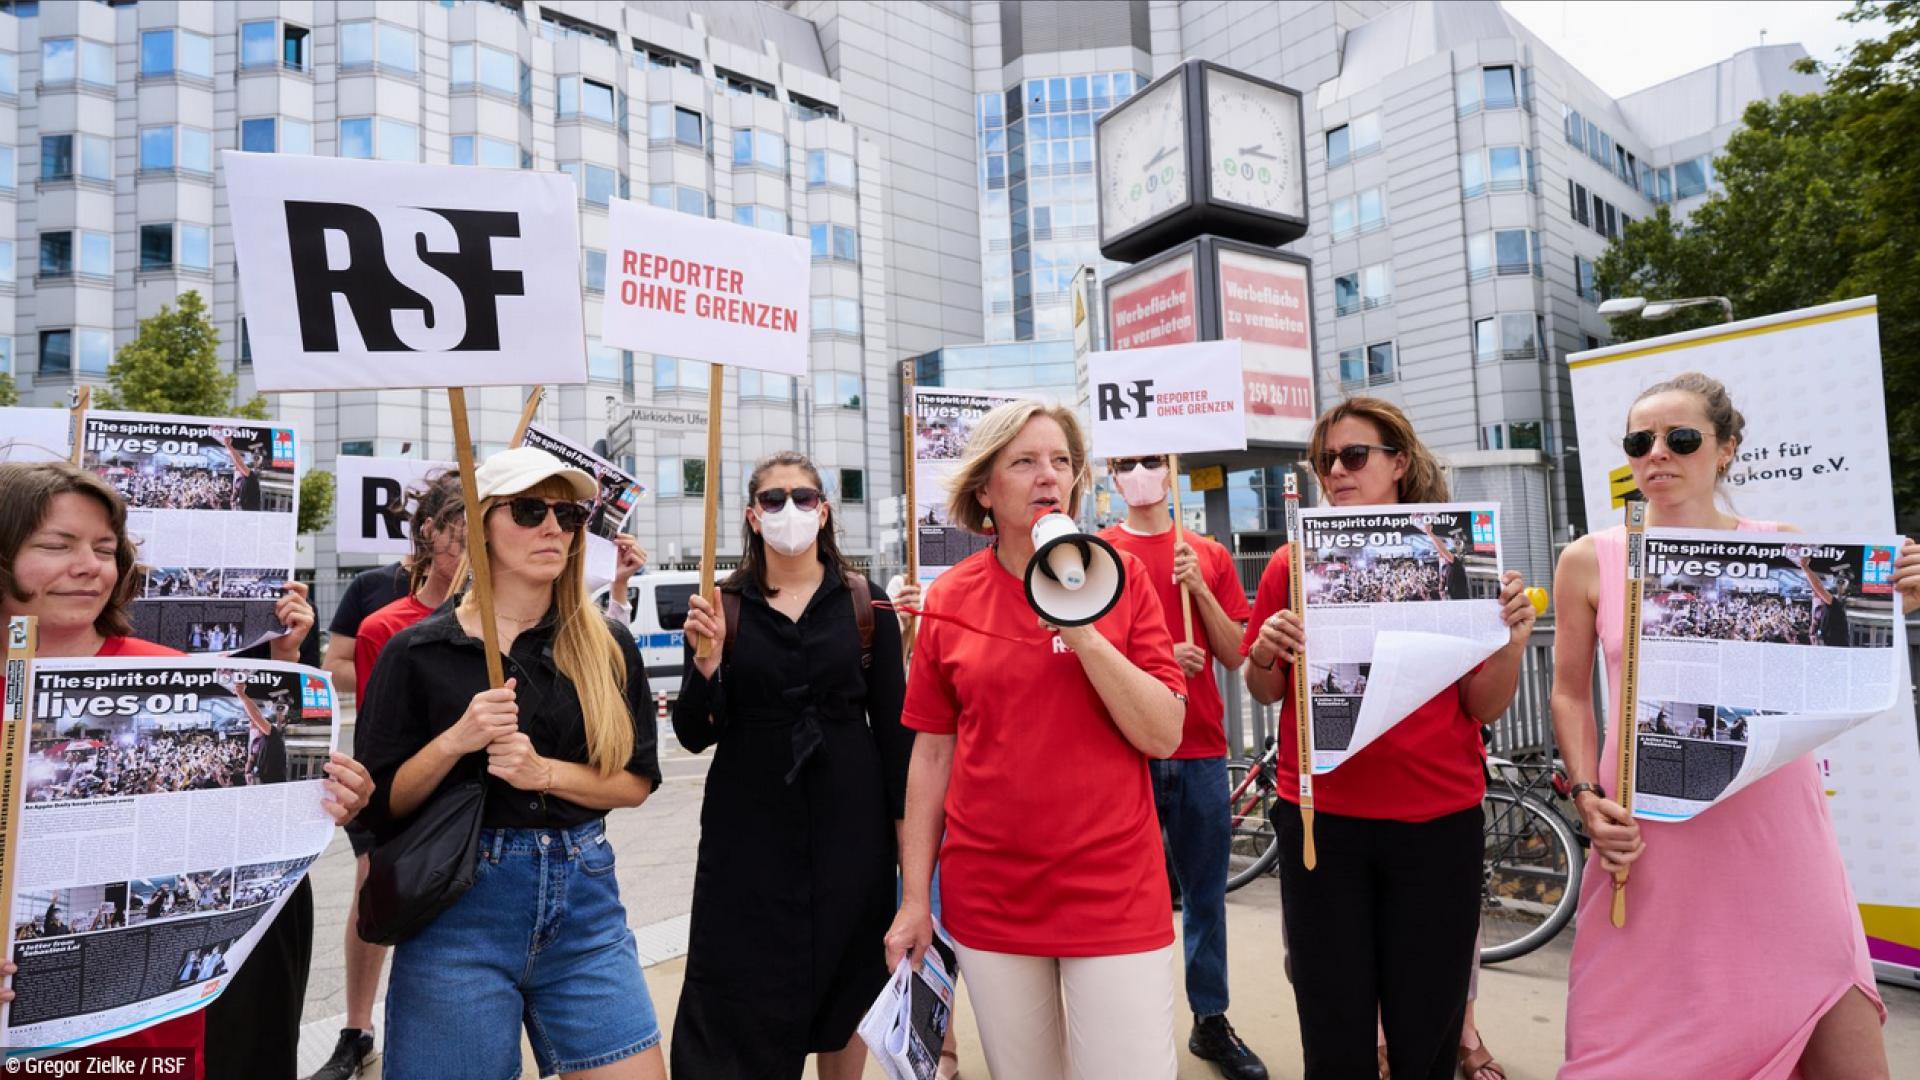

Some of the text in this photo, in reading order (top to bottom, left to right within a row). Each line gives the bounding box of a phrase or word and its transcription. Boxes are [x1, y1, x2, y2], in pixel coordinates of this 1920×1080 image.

[284, 200, 524, 352] RSF
[622, 249, 744, 295] REPORTER
[1226, 280, 1299, 309] Werbefläche
[620, 279, 798, 333] OHNE GRENZEN
[1115, 289, 1187, 328] Werbefläche
[1132, 314, 1192, 345] vermieten
[1228, 308, 1304, 333] zu vermieten
[919, 395, 935, 404] The
[936, 396, 960, 405] spirit
[1097, 379, 1154, 421] RSF
[1156, 390, 1208, 404] REPORTER
[1269, 383, 1289, 406] 267
[1291, 386, 1309, 408] 111
[631, 409, 685, 424] Märkisches
[918, 403, 983, 419] lives on
[1157, 401, 1234, 417] OHNE GRENZEN
[88, 420, 258, 441] The spirit of Apple Daily
[87, 433, 199, 455] lives on
[526, 429, 541, 443] The
[541, 439, 566, 455] spirit
[566, 450, 577, 460] of
[1778, 442, 1812, 458] für
[1812, 456, 1849, 474] e.V.
[1305, 514, 1458, 531] The spirit of Apple Daily
[1306, 529, 1403, 548] lives on
[1649, 542, 1846, 561] The spirit of Apple Daily
[1648, 555, 1720, 577] lives
[1726, 558, 1769, 578] on
[40, 671, 282, 690] The spirit of Apple Daily
[36, 692, 199, 719] lives on
